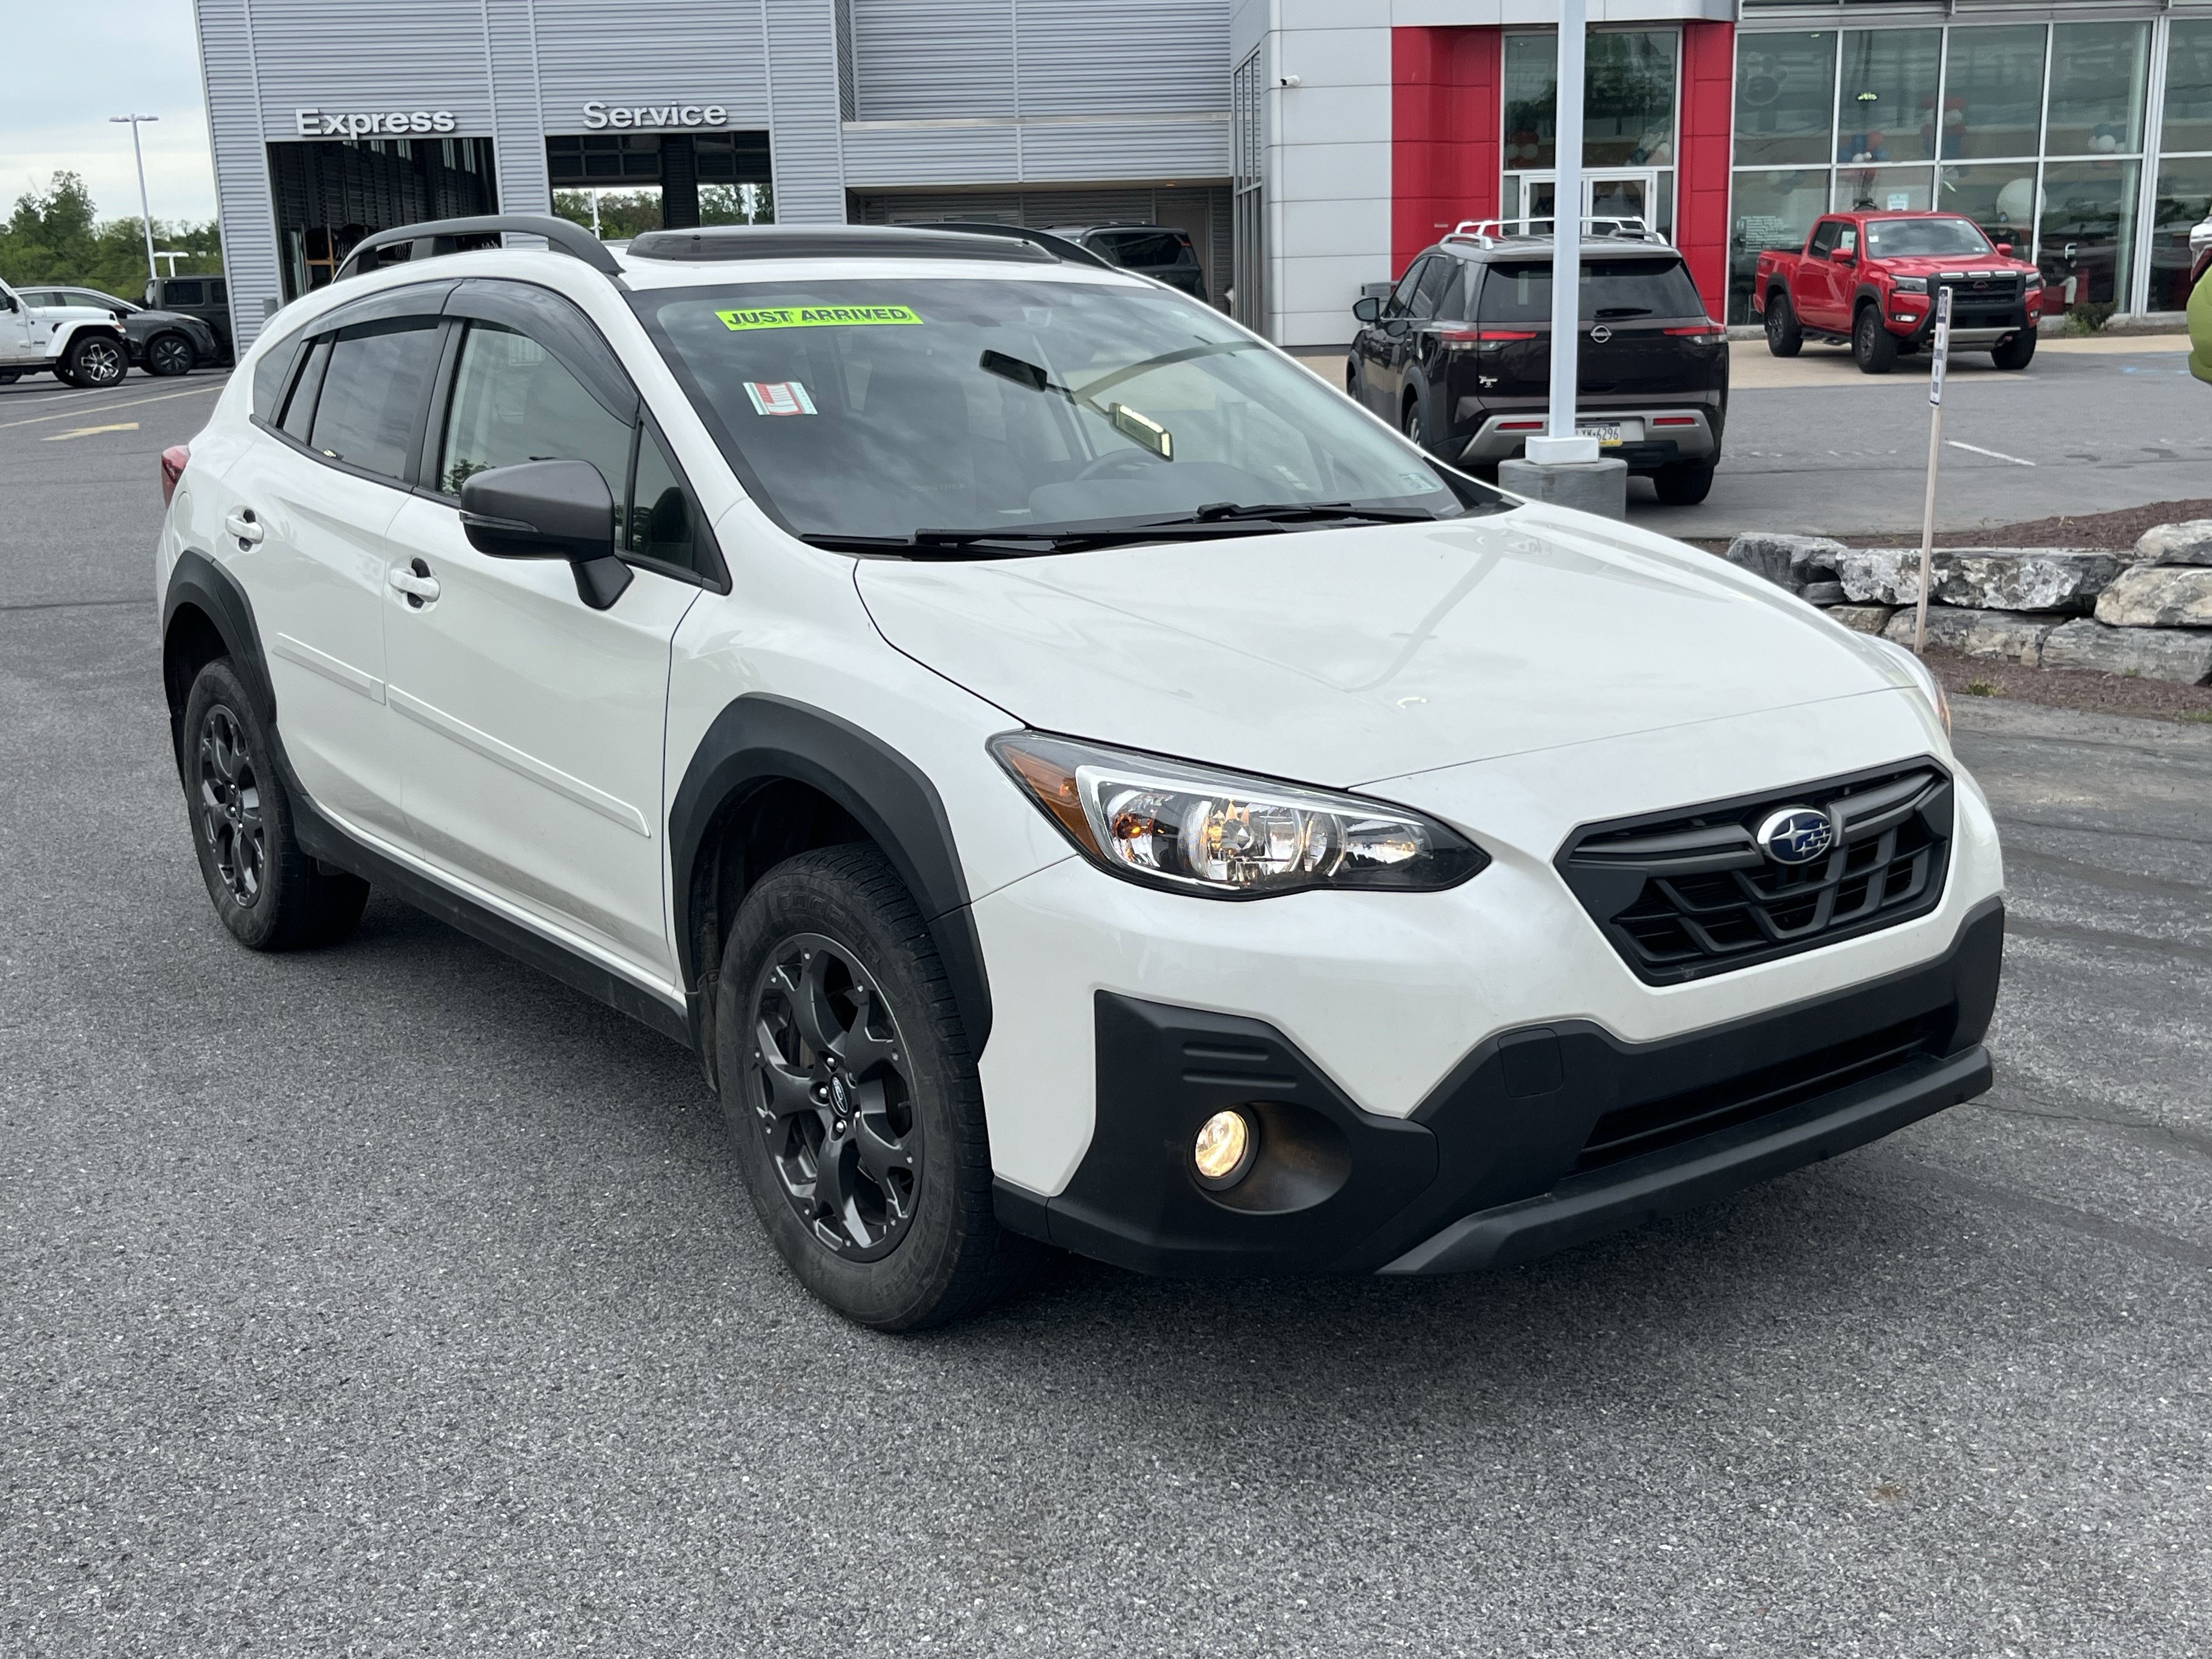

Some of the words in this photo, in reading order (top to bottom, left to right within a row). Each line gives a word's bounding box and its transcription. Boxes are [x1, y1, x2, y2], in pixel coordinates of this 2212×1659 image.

[295, 108, 456, 140] Express
[583, 101, 727, 129] Service
[728, 310, 793, 325] JUST
[802, 308, 911, 323] ARRIVED
[778, 890, 881, 963] COOPER
